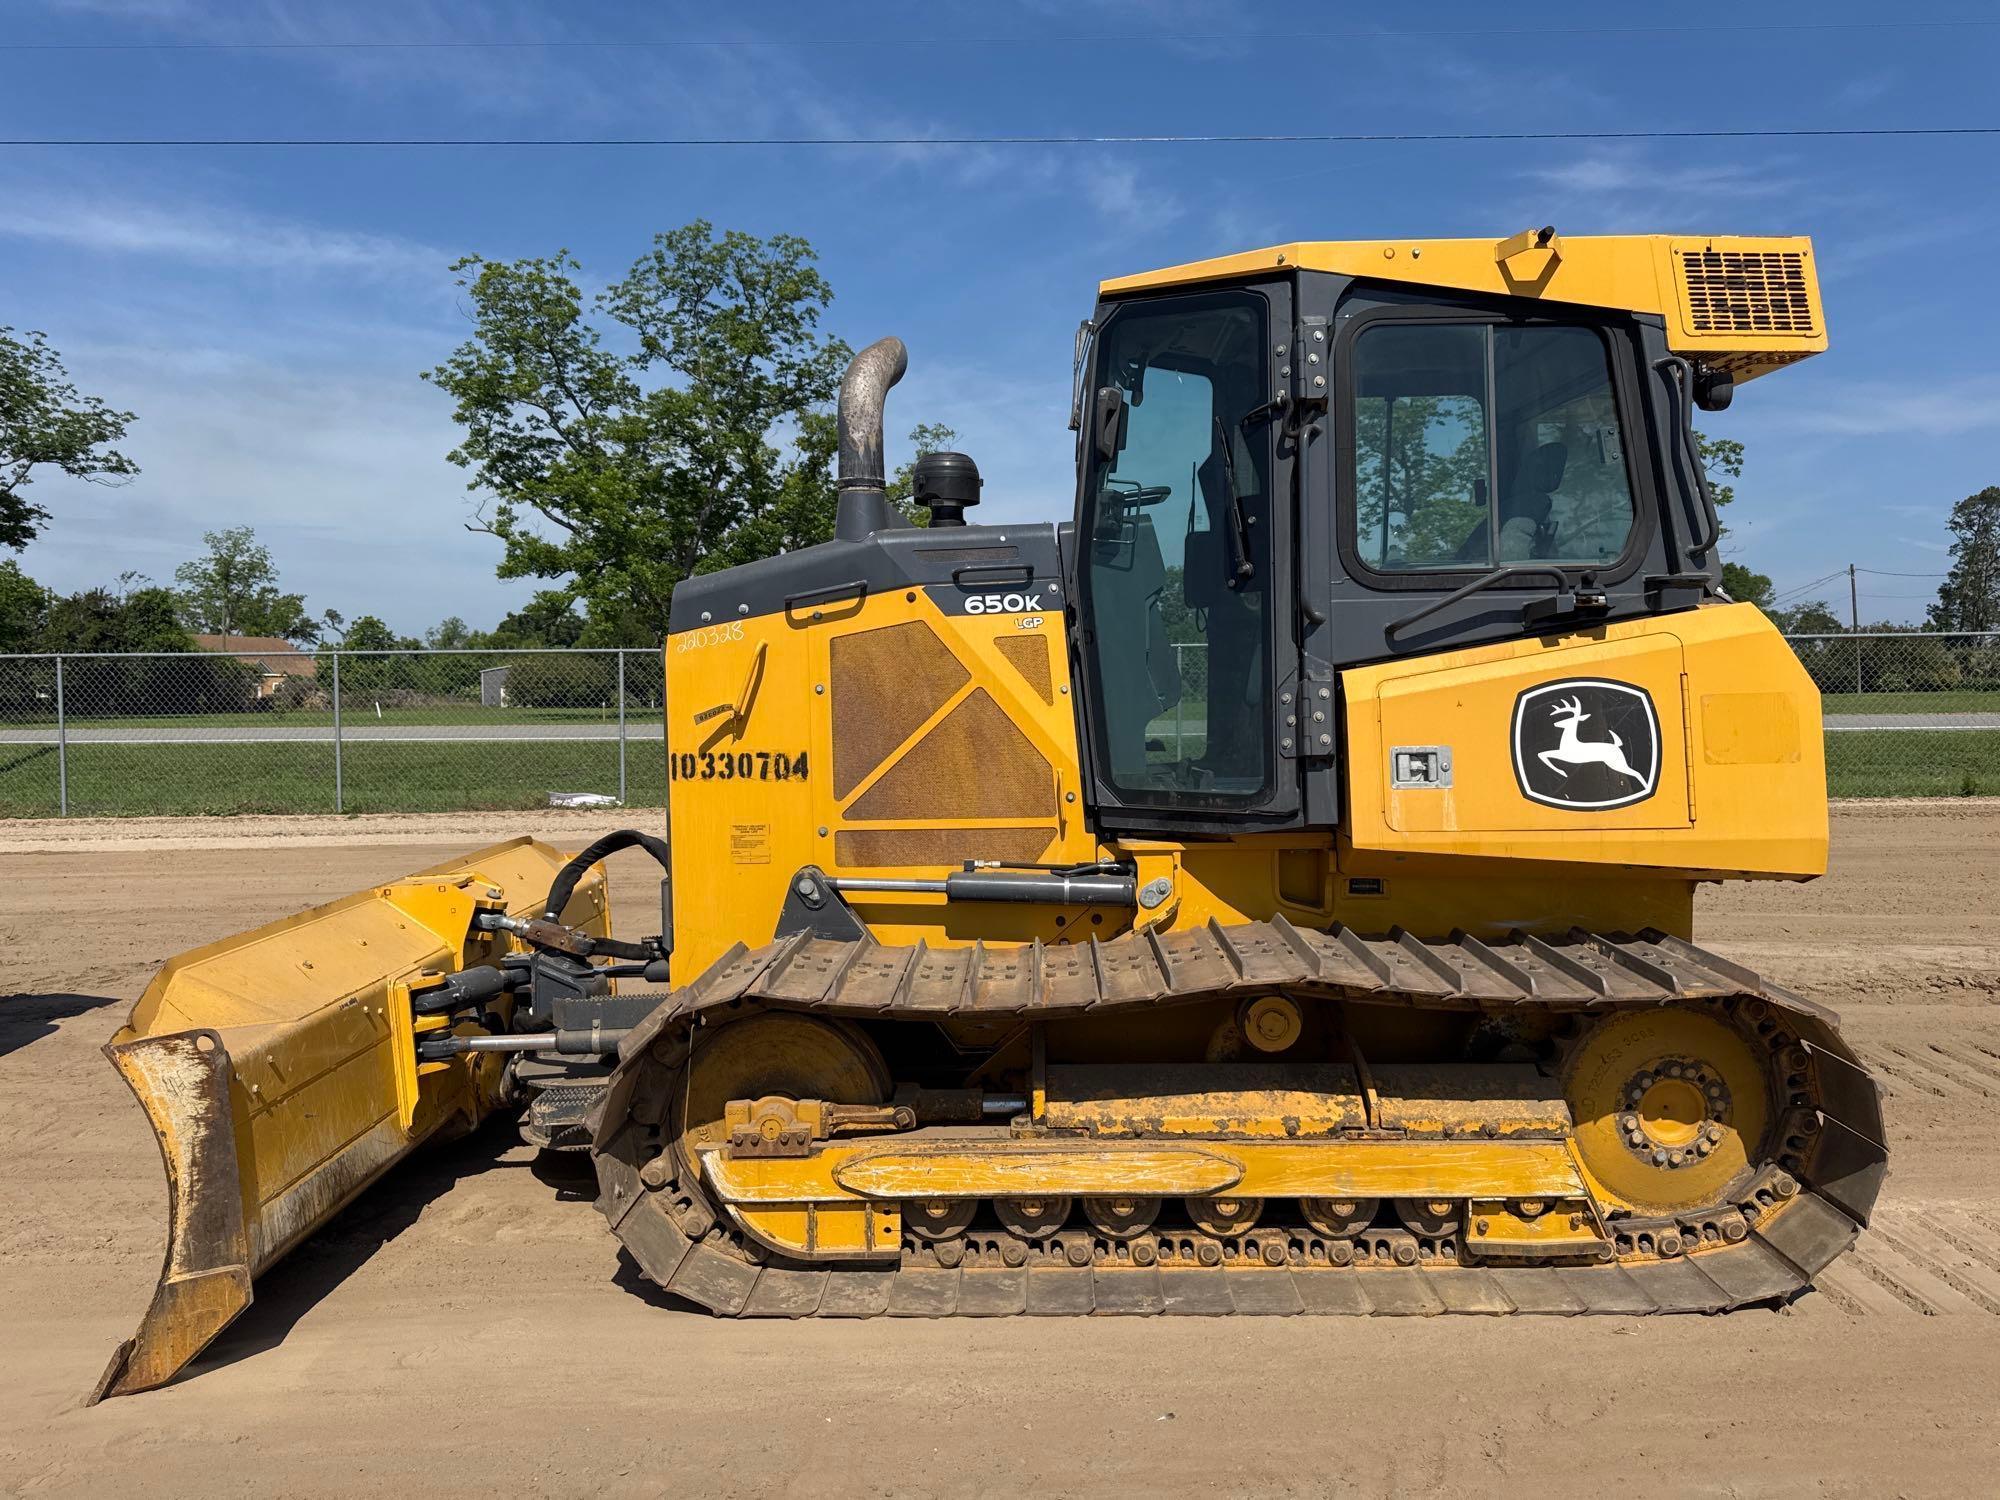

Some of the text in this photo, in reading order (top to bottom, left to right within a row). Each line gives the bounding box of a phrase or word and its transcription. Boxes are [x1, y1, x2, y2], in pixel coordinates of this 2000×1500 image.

[964, 593, 1043, 614] 650K
[676, 620, 744, 654] 220328
[671, 752, 808, 780] 10330704
